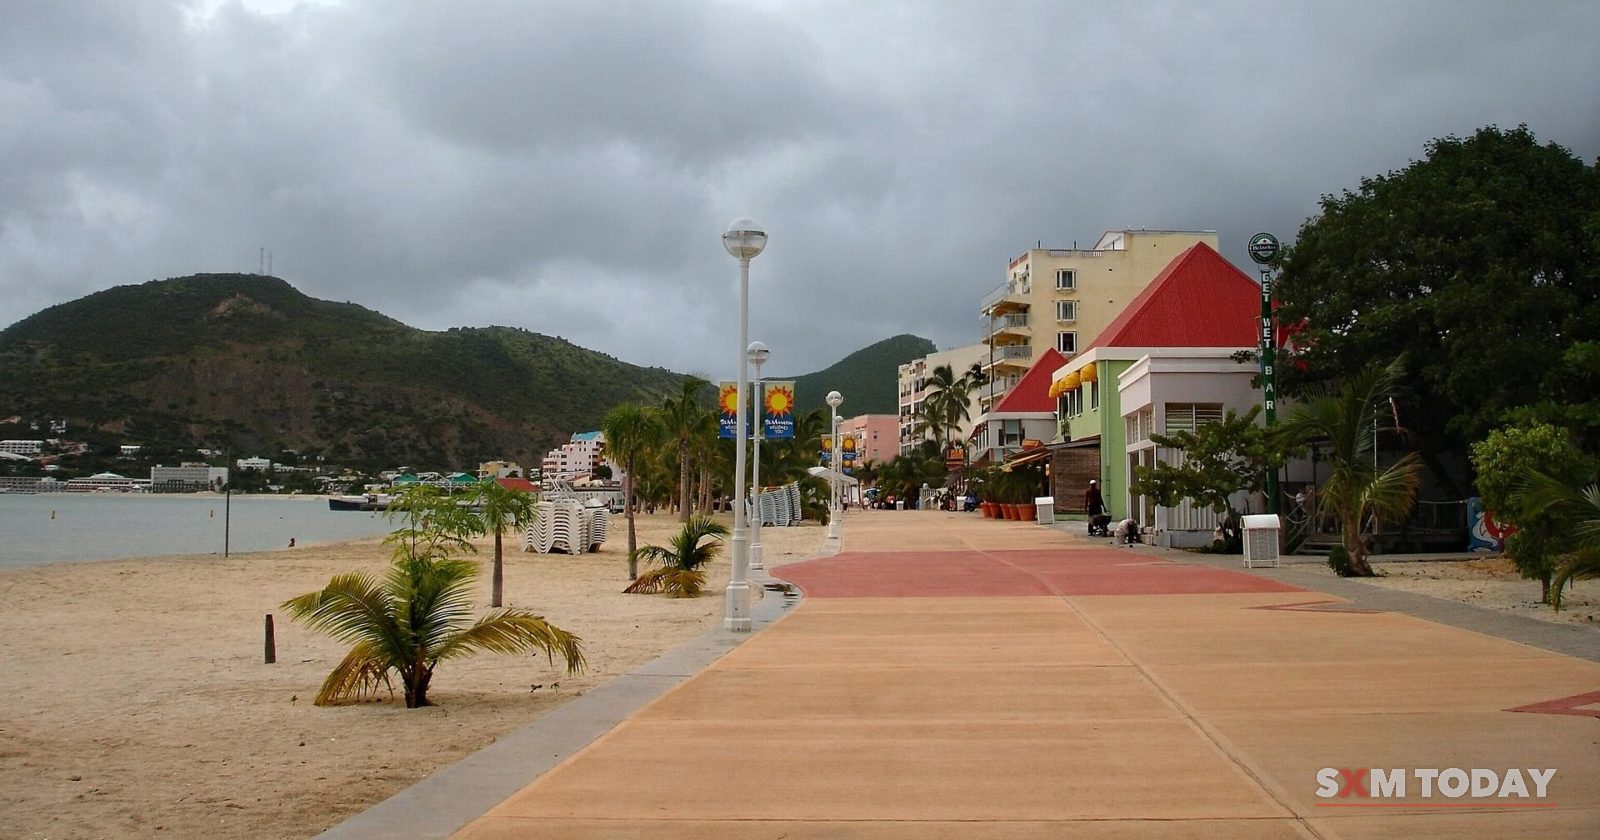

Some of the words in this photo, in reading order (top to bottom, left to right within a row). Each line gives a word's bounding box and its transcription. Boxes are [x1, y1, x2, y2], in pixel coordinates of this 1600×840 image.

[1262, 272, 1270, 302] GET
[1263, 318, 1271, 348] WET
[1265, 365, 1274, 410] BAR
